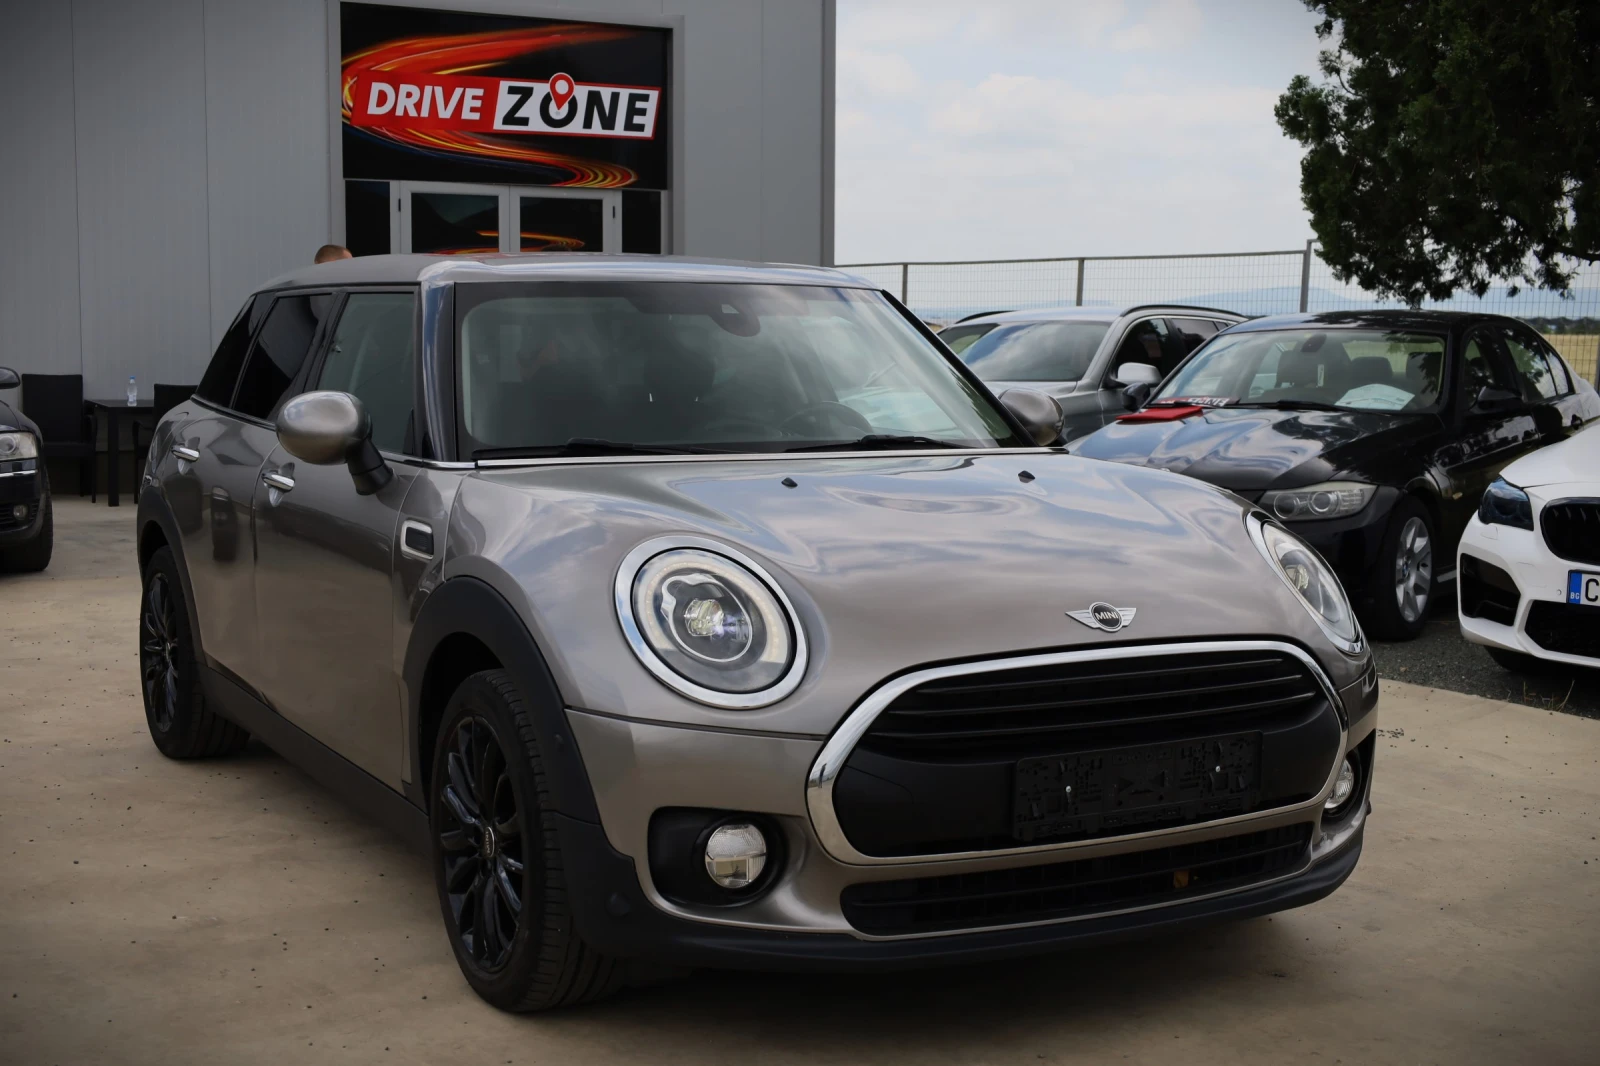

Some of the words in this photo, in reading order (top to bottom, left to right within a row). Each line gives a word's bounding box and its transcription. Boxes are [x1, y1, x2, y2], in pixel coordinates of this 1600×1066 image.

[367, 82, 485, 120] DRIVE
[502, 85, 650, 132] ZONE
[1585, 578, 1600, 602] C
[1094, 611, 1119, 620] MINI
